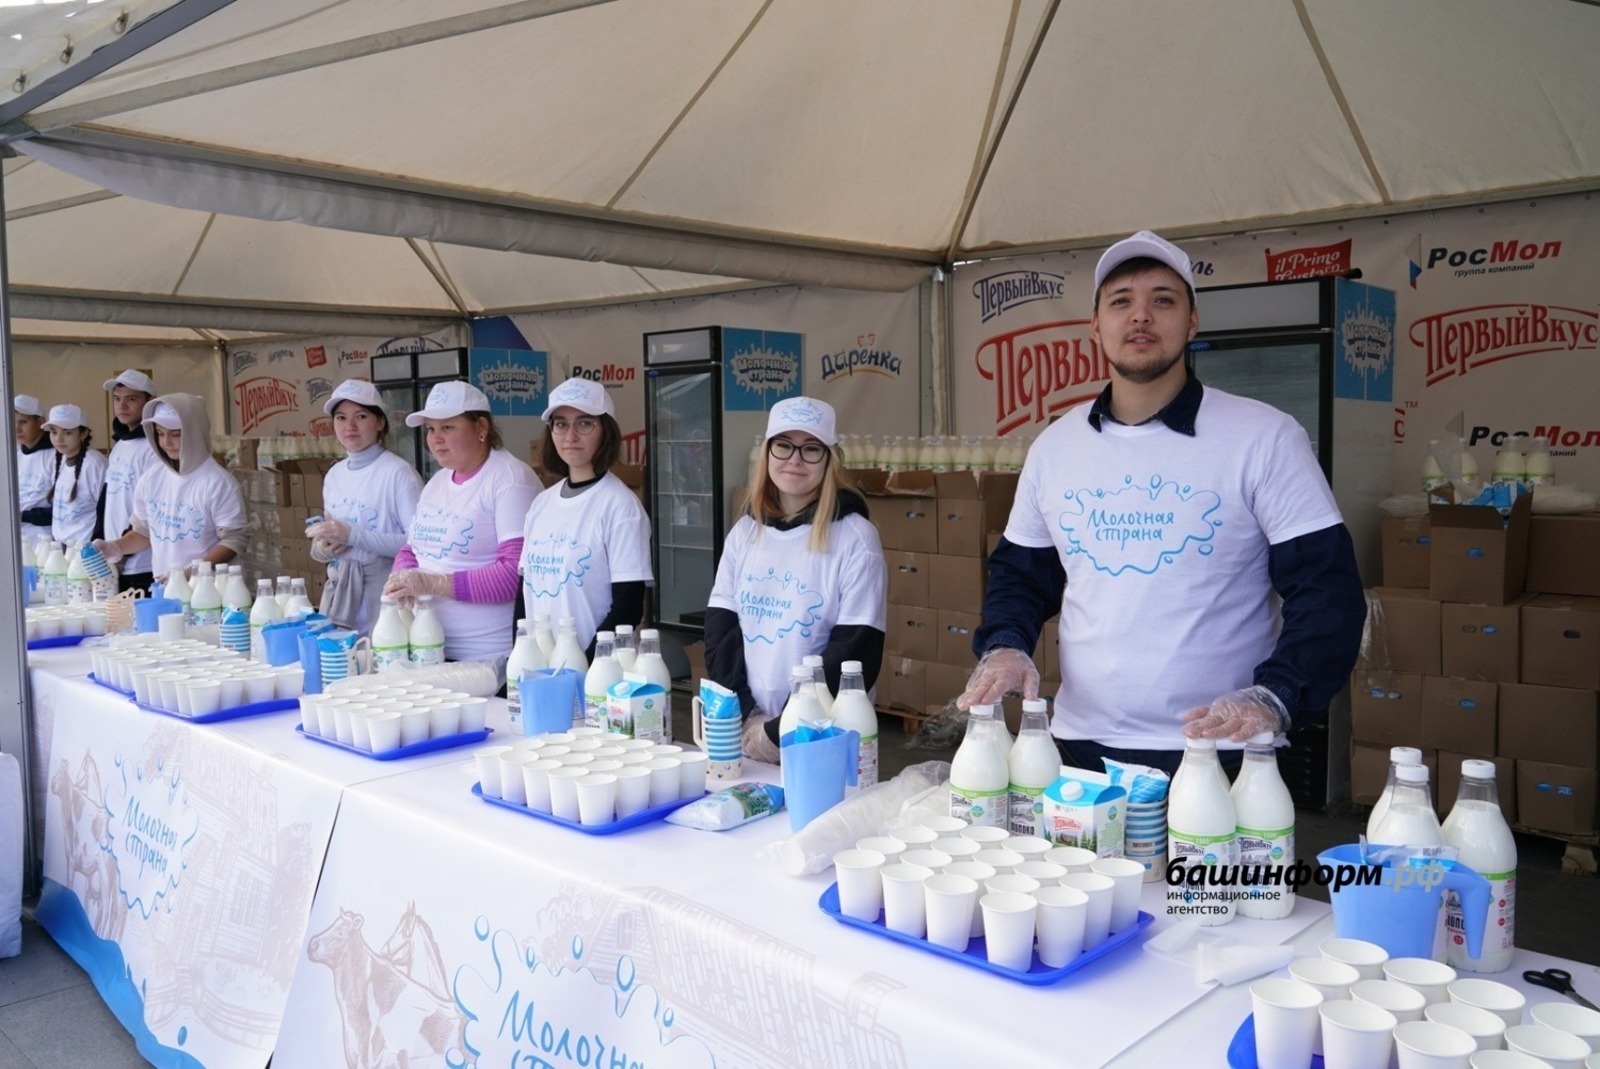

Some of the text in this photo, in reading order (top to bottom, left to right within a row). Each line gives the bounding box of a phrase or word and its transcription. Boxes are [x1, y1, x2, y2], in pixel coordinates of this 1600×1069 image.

[1288, 250, 1340, 269] Primo
[1427, 240, 1562, 269] РосМол
[1454, 262, 1535, 278] группа компаний
[972, 271, 1065, 324] ПервыйВкус
[1409, 304, 1600, 388] ПервыйВкус
[573, 364, 635, 382] РосМол
[737, 357, 793, 375] Молочная
[484, 371, 539, 389] Молочная
[749, 369, 785, 384] страна
[494, 382, 530, 393] страна
[1087, 508, 1174, 529] Молочная
[1096, 528, 1163, 550] страна
[740, 590, 792, 609] Молочная
[121, 795, 178, 851] Молочная
